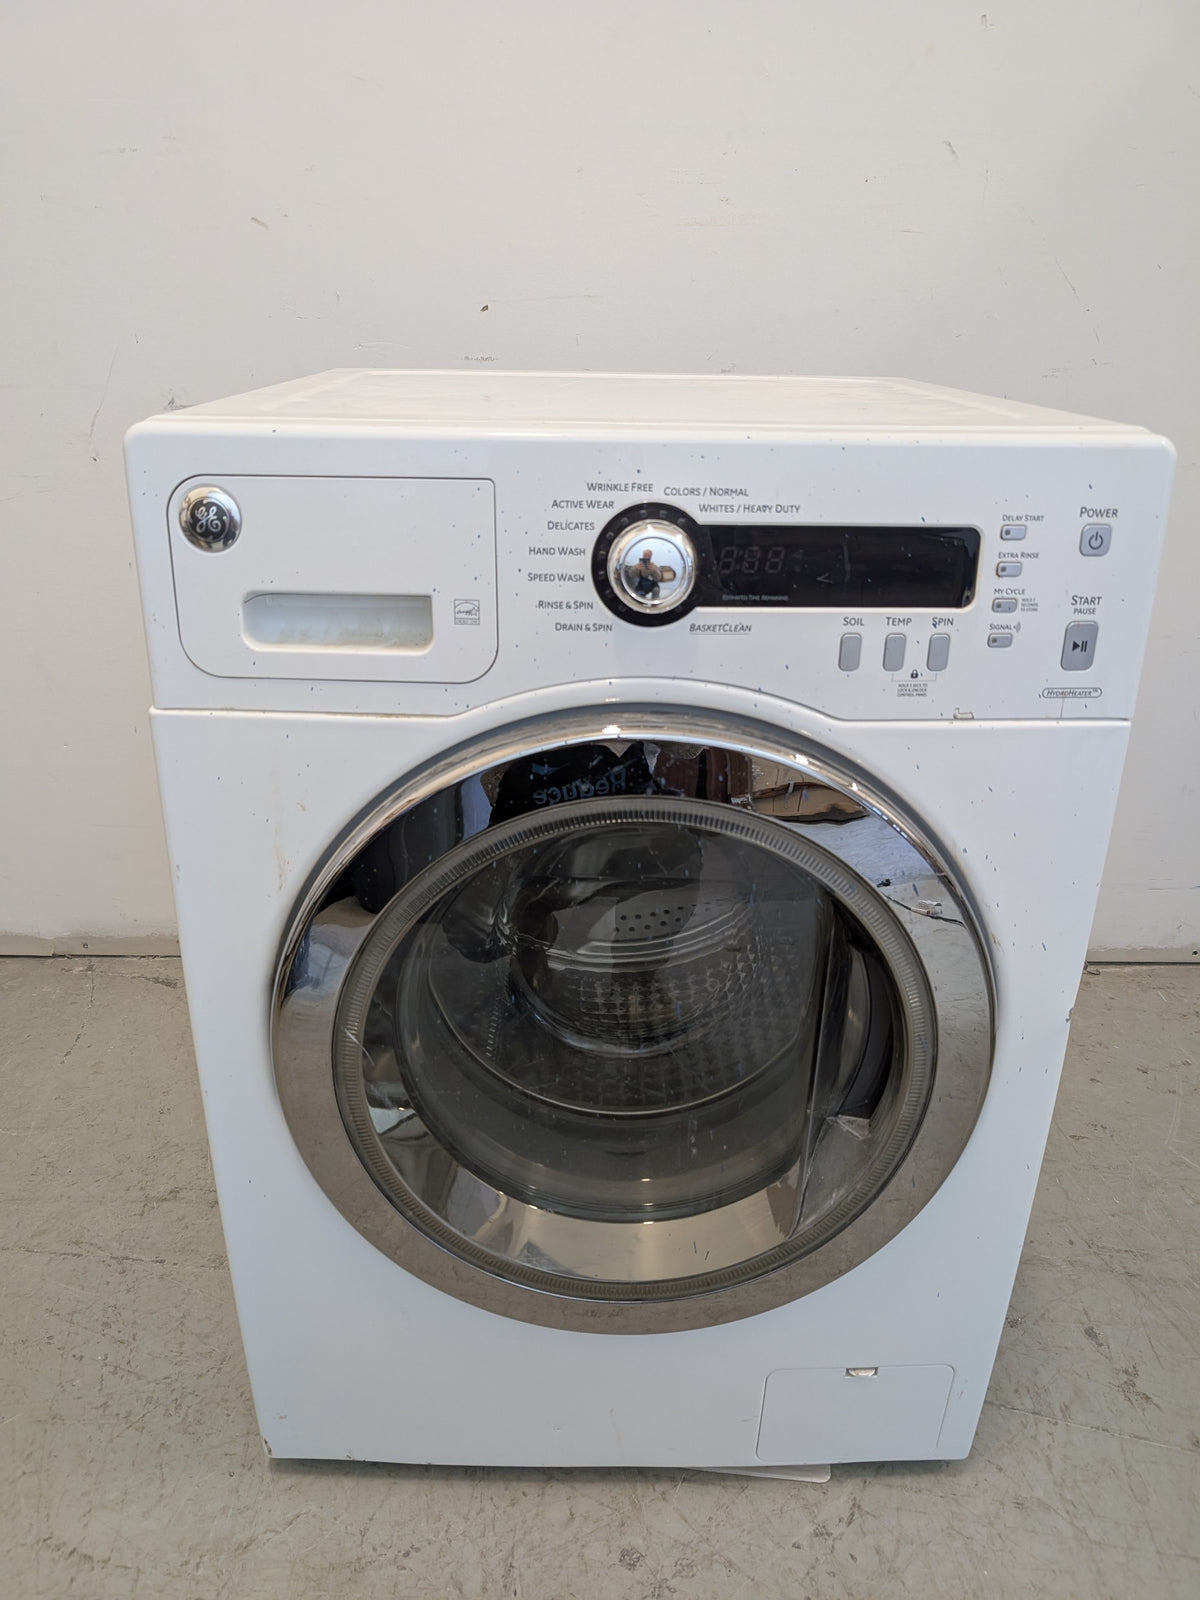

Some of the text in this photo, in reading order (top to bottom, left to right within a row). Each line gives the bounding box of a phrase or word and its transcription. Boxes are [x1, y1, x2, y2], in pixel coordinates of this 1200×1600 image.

[587, 482, 653, 492] WRINKLE FREE
[663, 487, 749, 497] COLORS / NORMAL
[552, 500, 614, 509] ACTIVE WEAR
[698, 504, 801, 513] WHITES / HEAVY DUTY
[1079, 506, 1118, 518] POWER
[1024, 514, 1044, 522] START
[547, 521, 595, 531] DELICATES
[529, 547, 586, 556] HAND WASH
[527, 573, 585, 582] SPEED WASH
[538, 600, 594, 610] RINSE & SPIN
[1071, 595, 1102, 606] START
[843, 616, 864, 626] SOIL
[886, 616, 912, 626] TEMP
[932, 616, 954, 627] SPIN
[555, 623, 613, 632] DRAIN & SPIN
